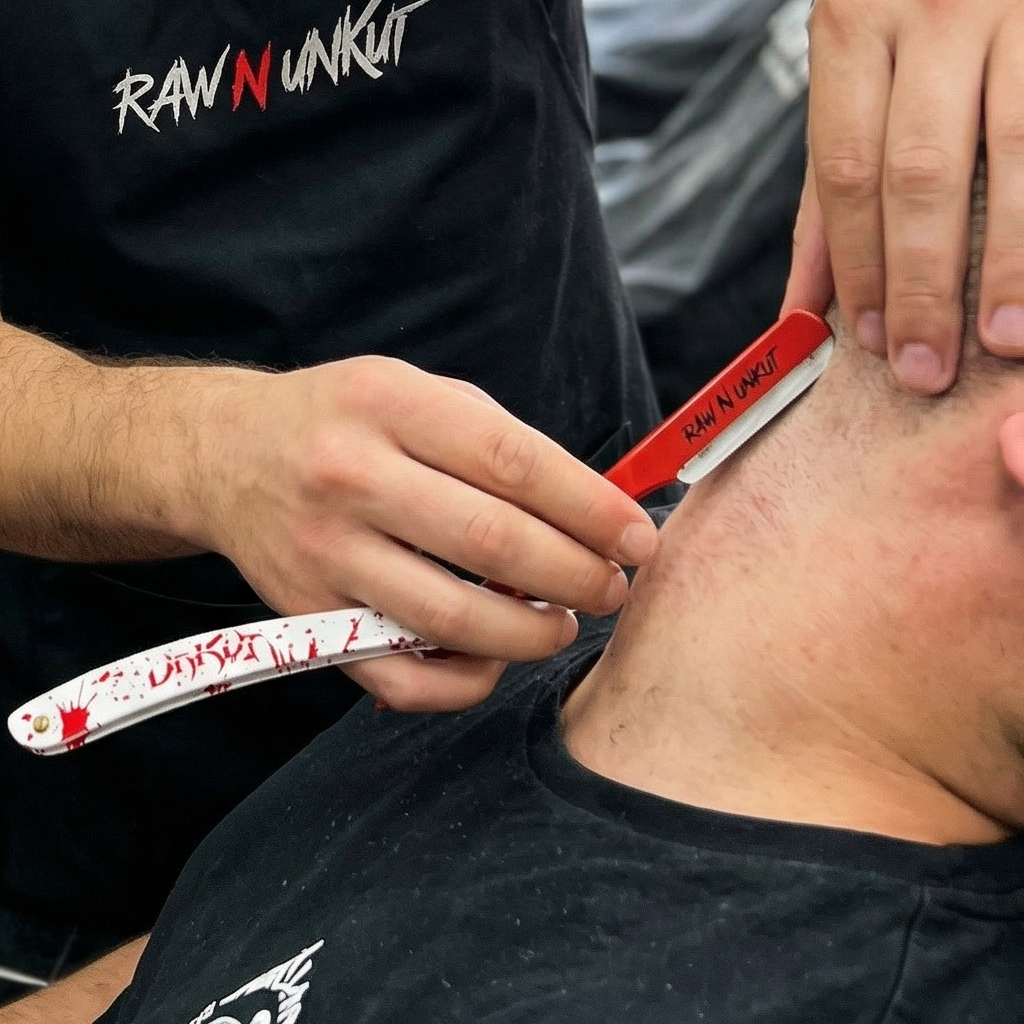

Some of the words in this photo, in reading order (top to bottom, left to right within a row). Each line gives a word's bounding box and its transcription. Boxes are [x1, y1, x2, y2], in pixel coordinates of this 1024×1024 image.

[113, 43, 230, 135] RAW
[232, 41, 271, 111] N
[681, 402, 716, 444] RAW
[716, 384, 735, 414] N
[733, 345, 778, 400] UNKUT
